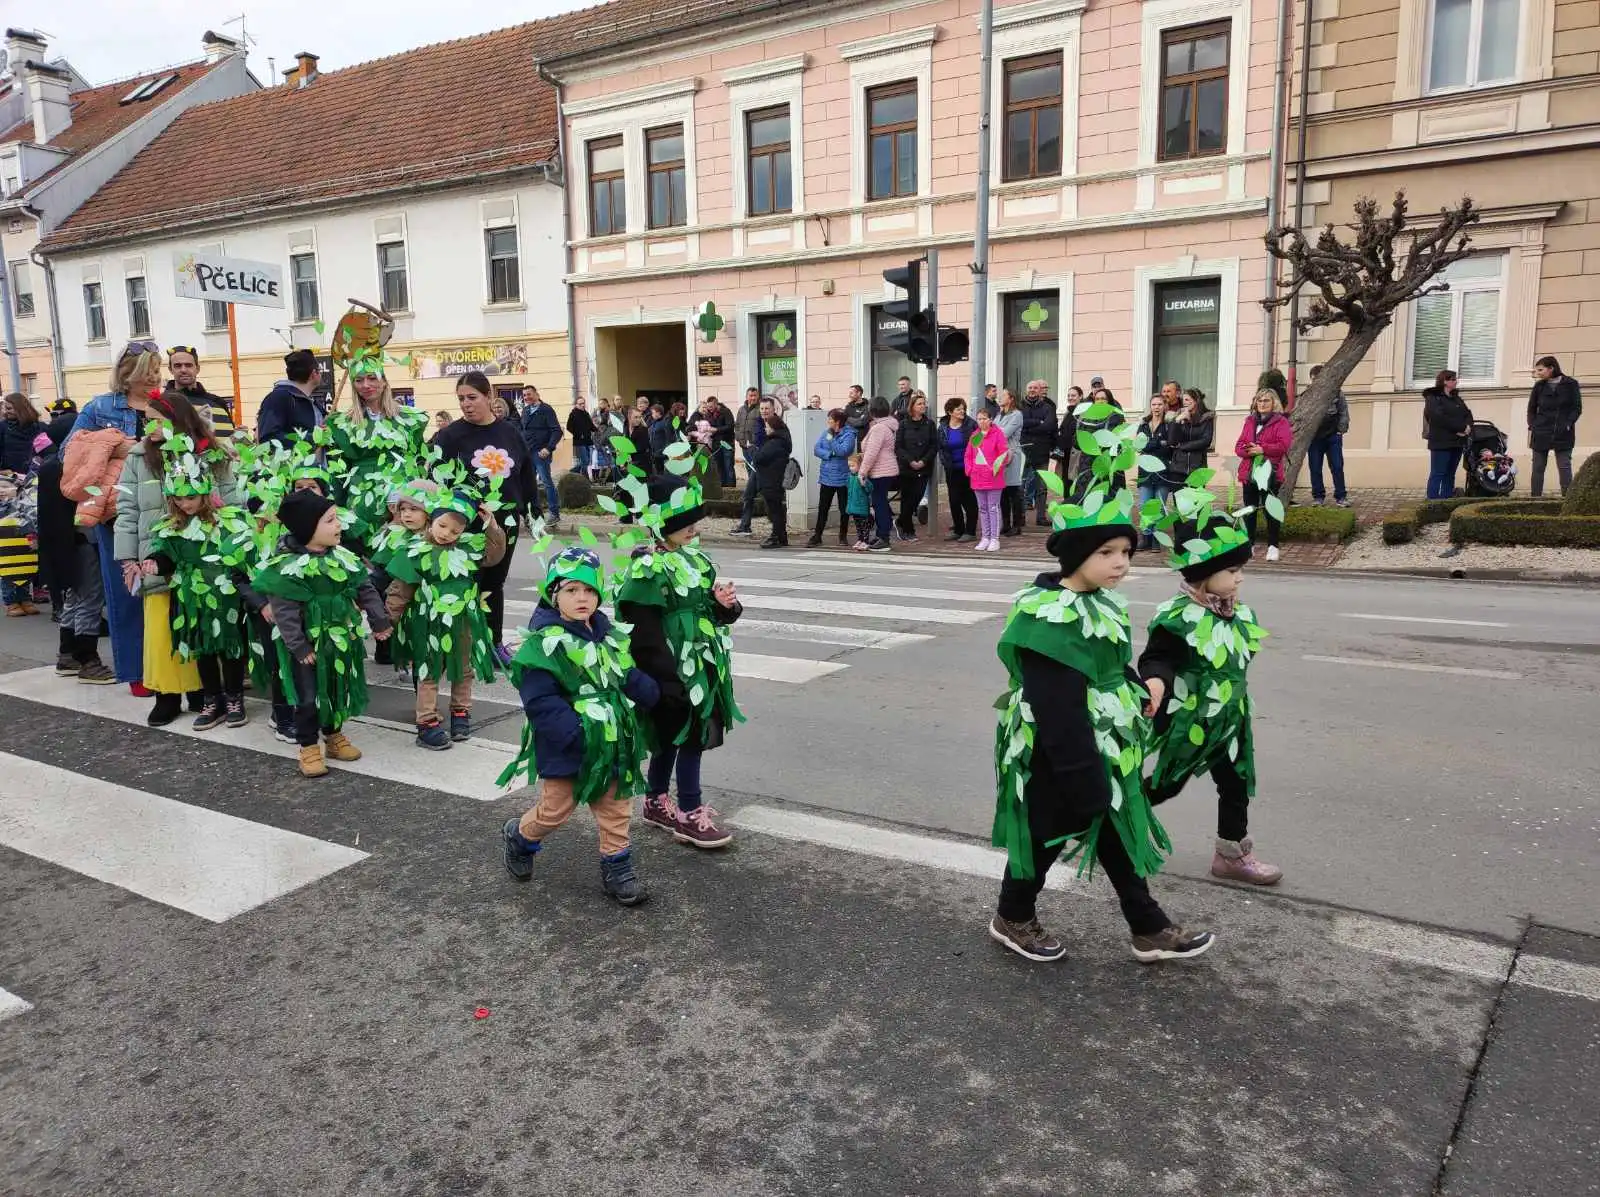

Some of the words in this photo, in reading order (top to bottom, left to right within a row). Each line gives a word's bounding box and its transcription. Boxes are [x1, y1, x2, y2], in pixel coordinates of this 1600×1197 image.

[195, 263, 279, 297] PČELICE
[1165, 299, 1215, 310] LJEKARNA
[446, 364, 466, 374] OPEN
